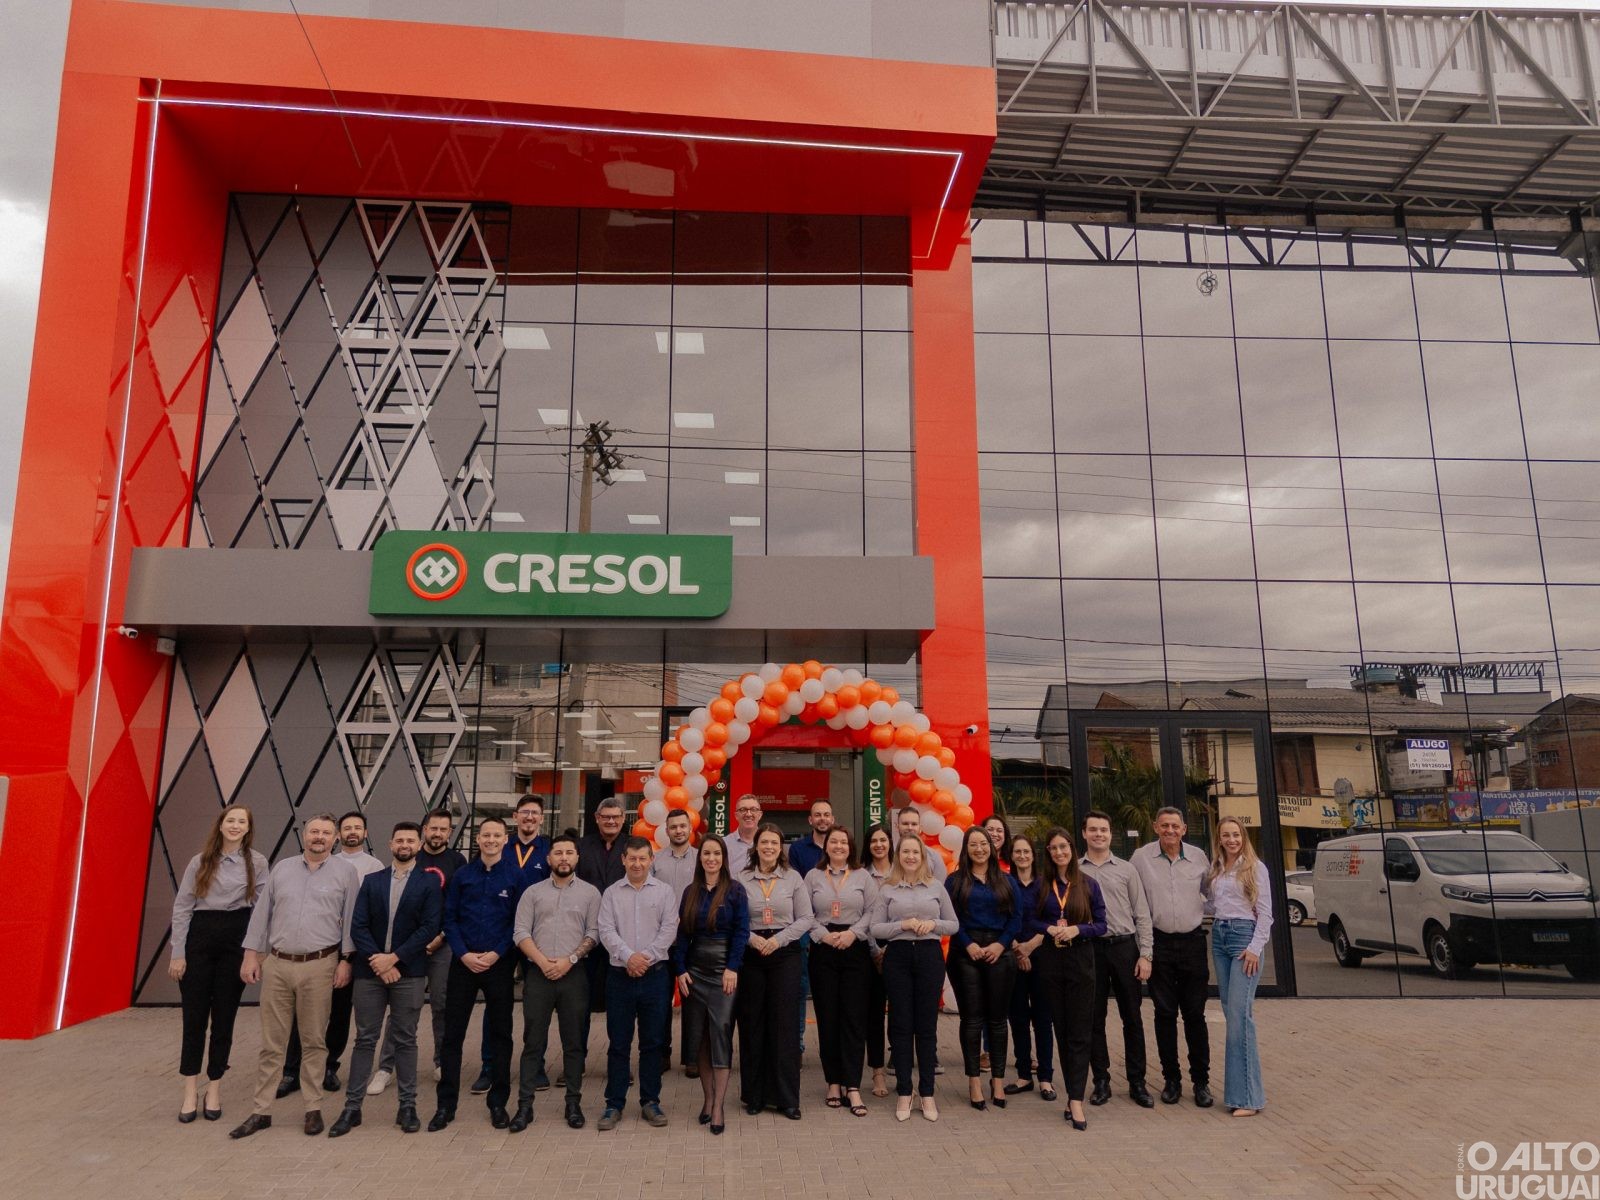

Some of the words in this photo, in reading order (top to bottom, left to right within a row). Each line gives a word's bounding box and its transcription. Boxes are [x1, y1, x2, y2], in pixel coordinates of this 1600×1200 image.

[483, 553, 699, 594] CRESOL
[1411, 740, 1446, 748] ALUGO
[715, 795, 725, 837] RESOL
[869, 779, 881, 826] MENTO
